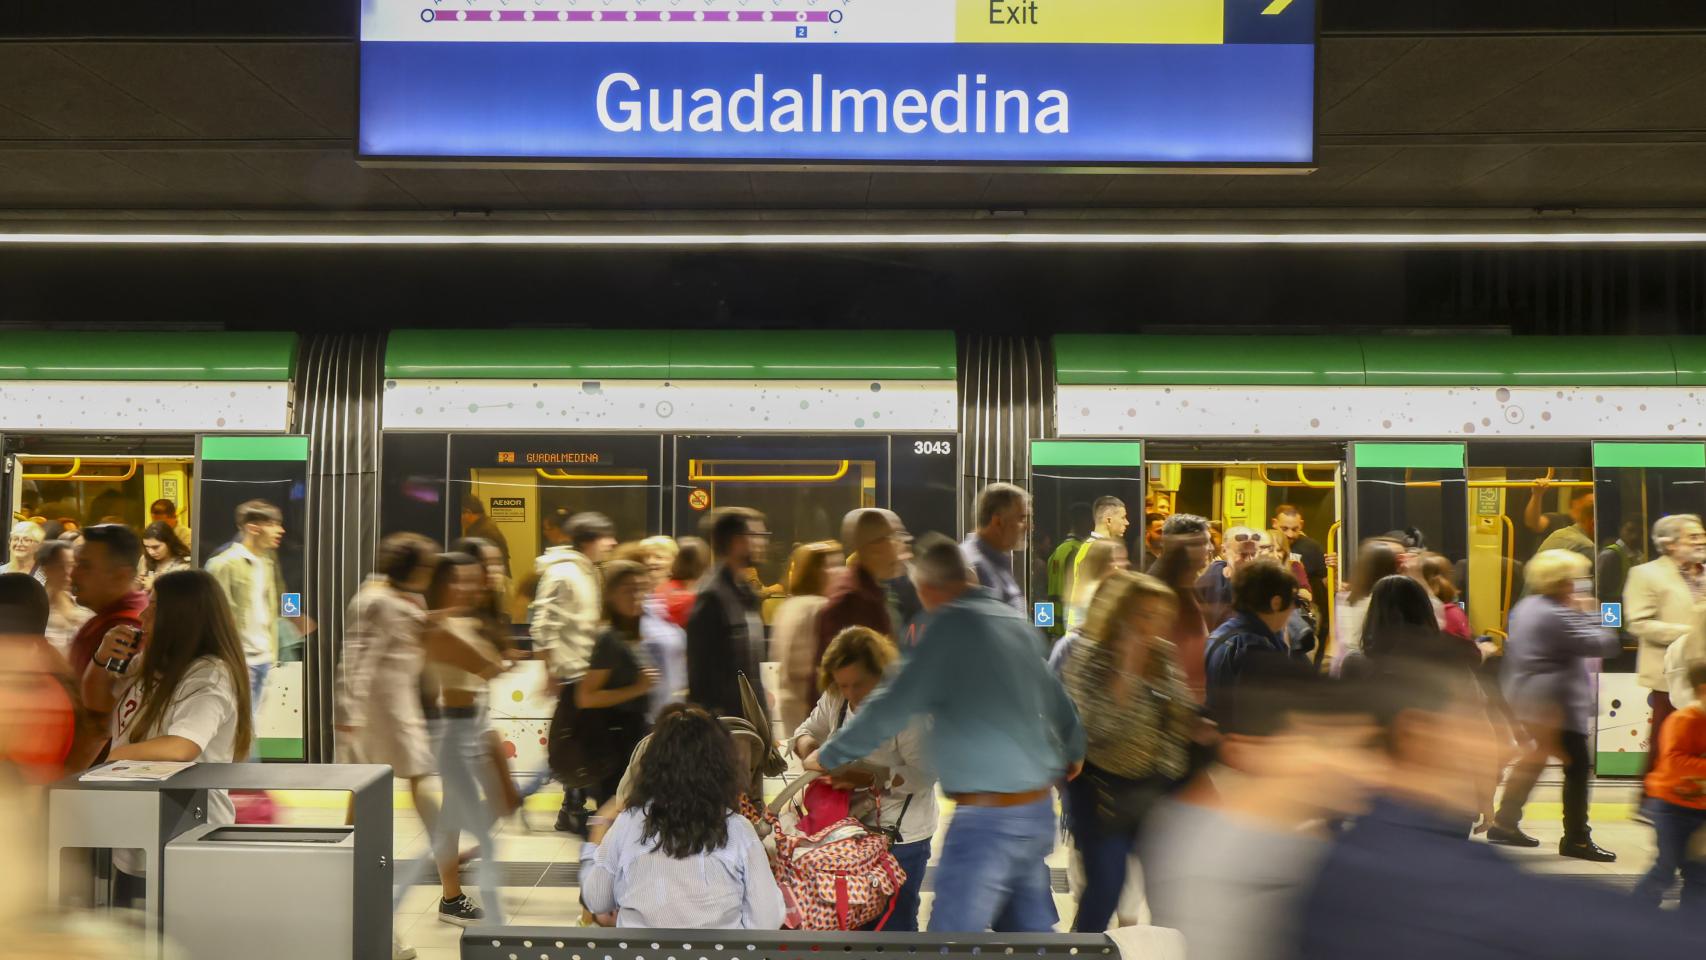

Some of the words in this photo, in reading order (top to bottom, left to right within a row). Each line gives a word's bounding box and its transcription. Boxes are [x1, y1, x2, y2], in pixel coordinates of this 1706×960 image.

[989, 0, 1038, 25] Exit
[596, 72, 1069, 134] Guadalmedina
[914, 440, 951, 455] 3043
[526, 453, 599, 463] GUADALMEDINA
